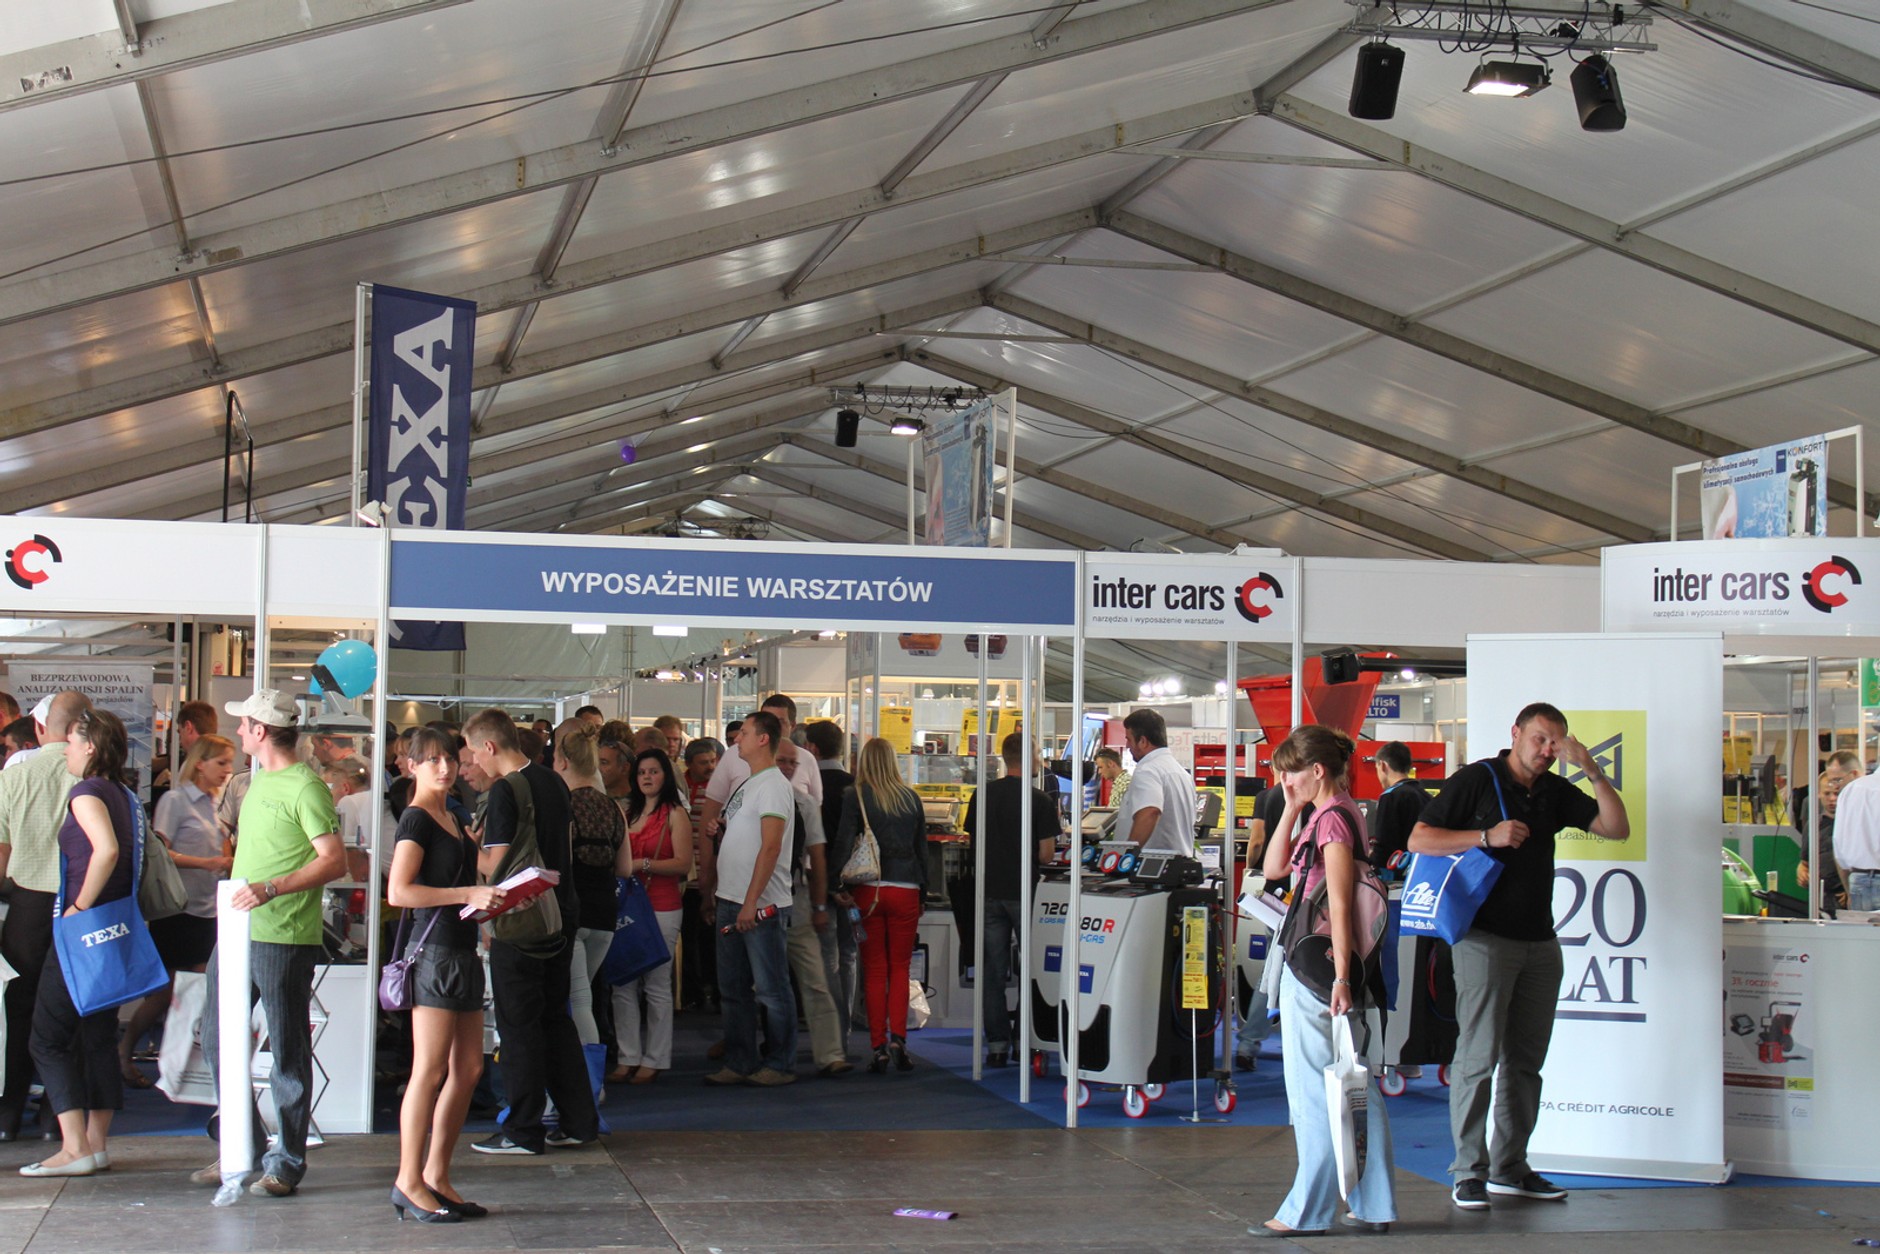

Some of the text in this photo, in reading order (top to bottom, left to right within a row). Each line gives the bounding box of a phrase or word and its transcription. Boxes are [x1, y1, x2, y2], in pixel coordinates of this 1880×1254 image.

[386, 307, 453, 530] EXA
[1787, 441, 1822, 457] KONFORT
[541, 569, 933, 603] WYPOSAŻENIE WARSZTATÓW
[1653, 567, 1790, 602] inter cars
[1093, 575, 1225, 611] inter cars
[1092, 615, 1128, 624] narzędzia
[1135, 615, 1182, 625] wyposażenie
[1184, 616, 1225, 625] warsztatów
[1653, 608, 1685, 619] narzędzia
[1690, 607, 1740, 618] wyposażenie
[1743, 606, 1790, 617] warsztatów
[30, 673, 132, 683] BEZPRZEWODOWA
[17, 685, 63, 694] ANALIZA
[104, 685, 144, 694] SPALIN
[1371, 697, 1398, 707] lfisk
[1366, 707, 1389, 717] LTO
[1553, 866, 1647, 948] 20
[1080, 916, 1115, 933] 80R
[81, 922, 130, 948] TEXA
[1557, 1101, 1605, 1113] CRÉDIT
[1608, 1104, 1675, 1117] AGRICOLE
